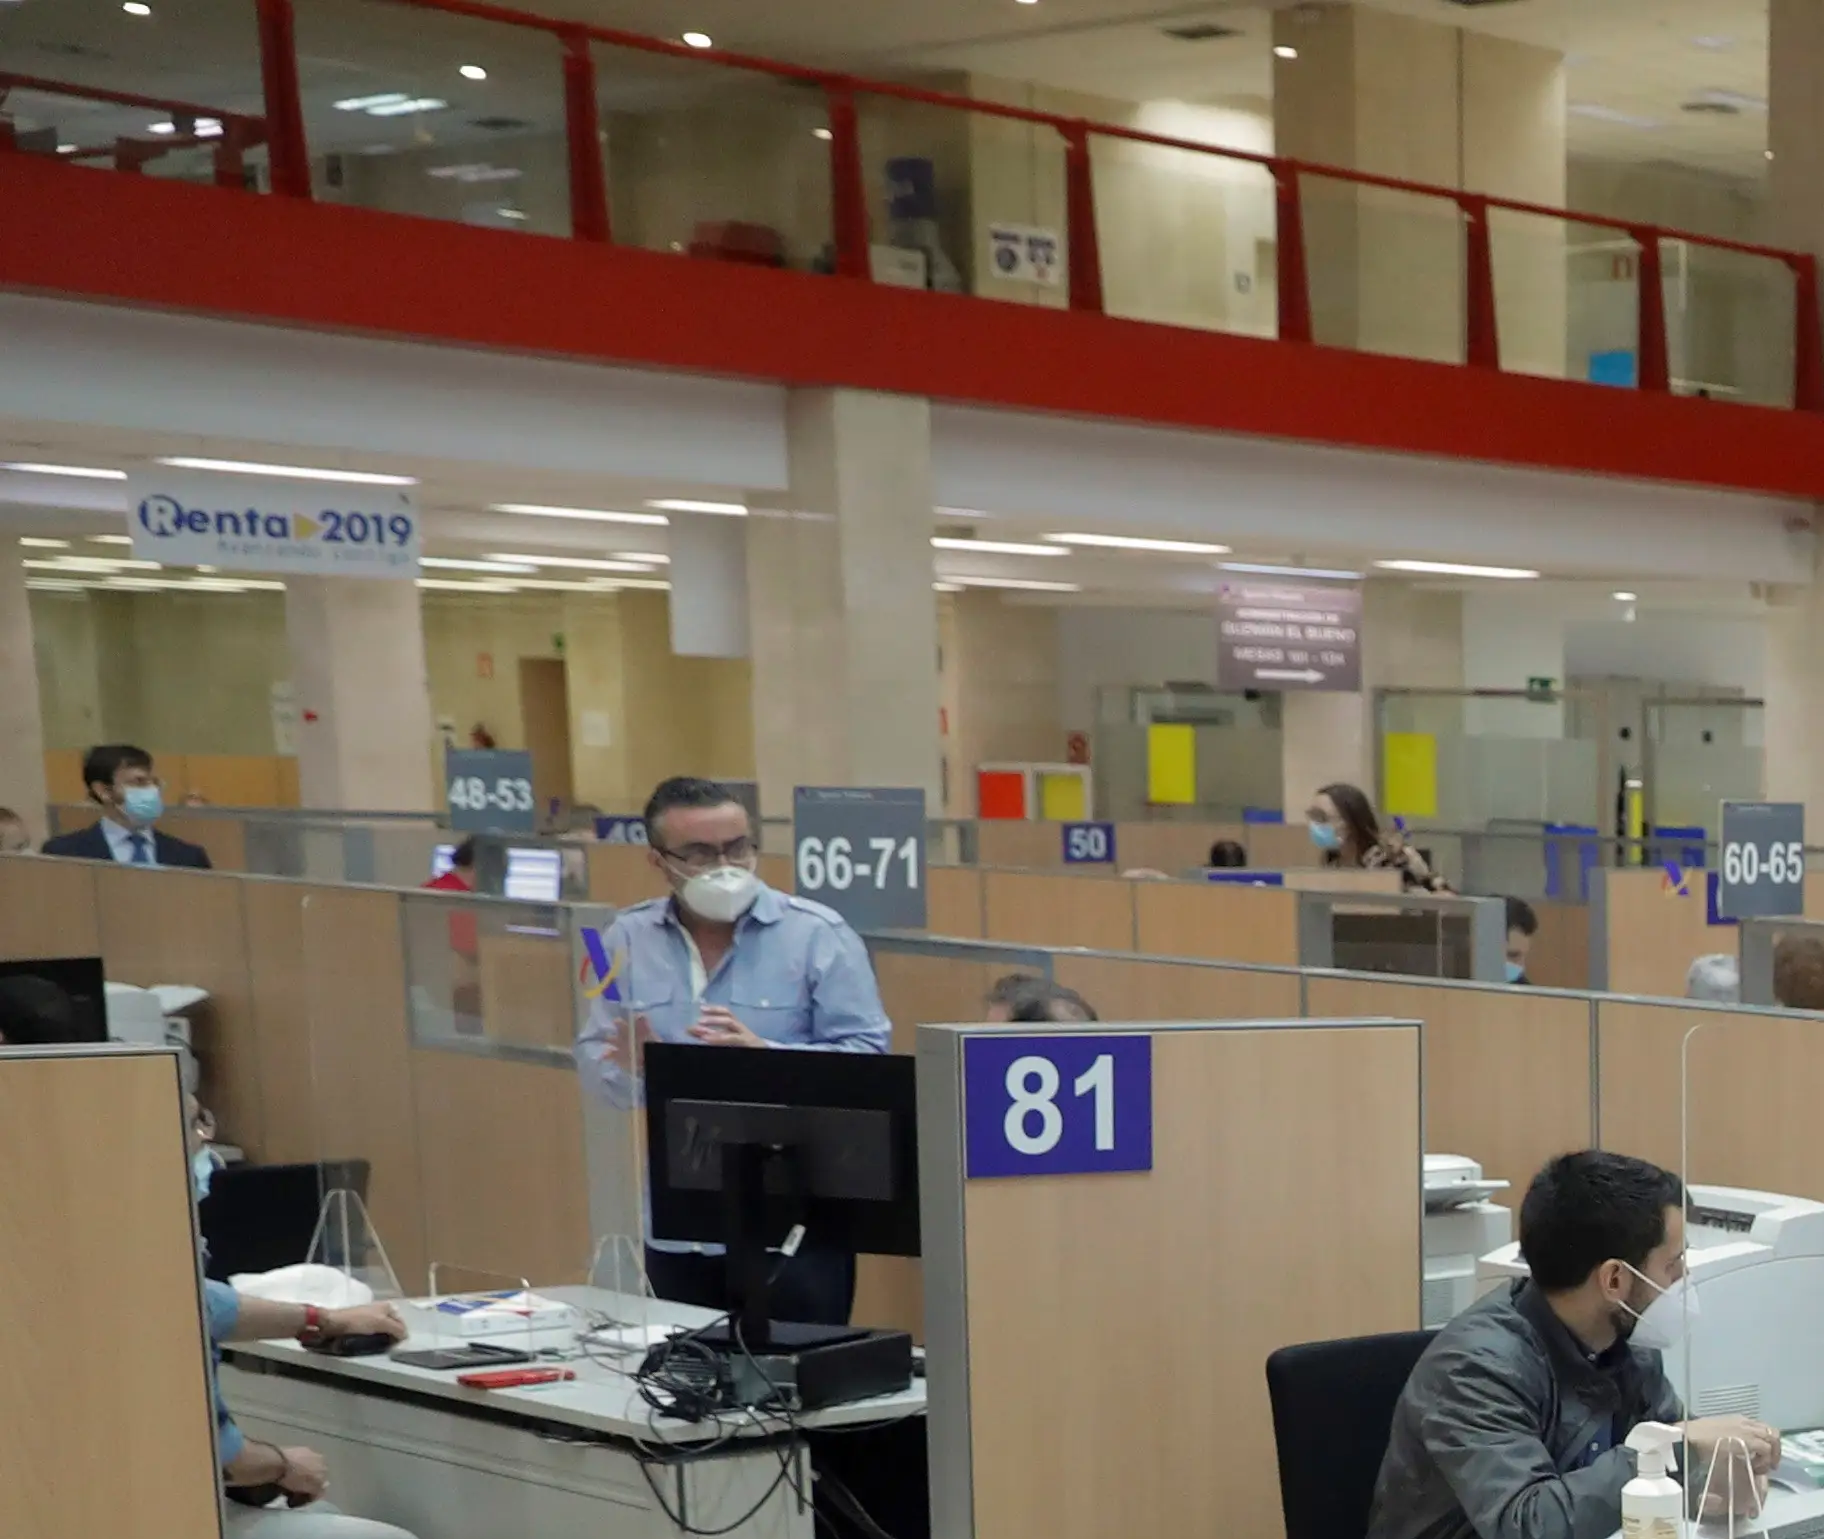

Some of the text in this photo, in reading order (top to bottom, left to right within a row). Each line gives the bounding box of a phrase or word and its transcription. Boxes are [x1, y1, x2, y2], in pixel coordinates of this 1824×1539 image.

[138, 494, 412, 547] Renta 2019
[449, 775, 533, 811] 48-53
[797, 836, 919, 890] 66-71
[1069, 828, 1107, 859] 50
[1724, 841, 1803, 885] 60-65
[1003, 1054, 1115, 1156] 81
